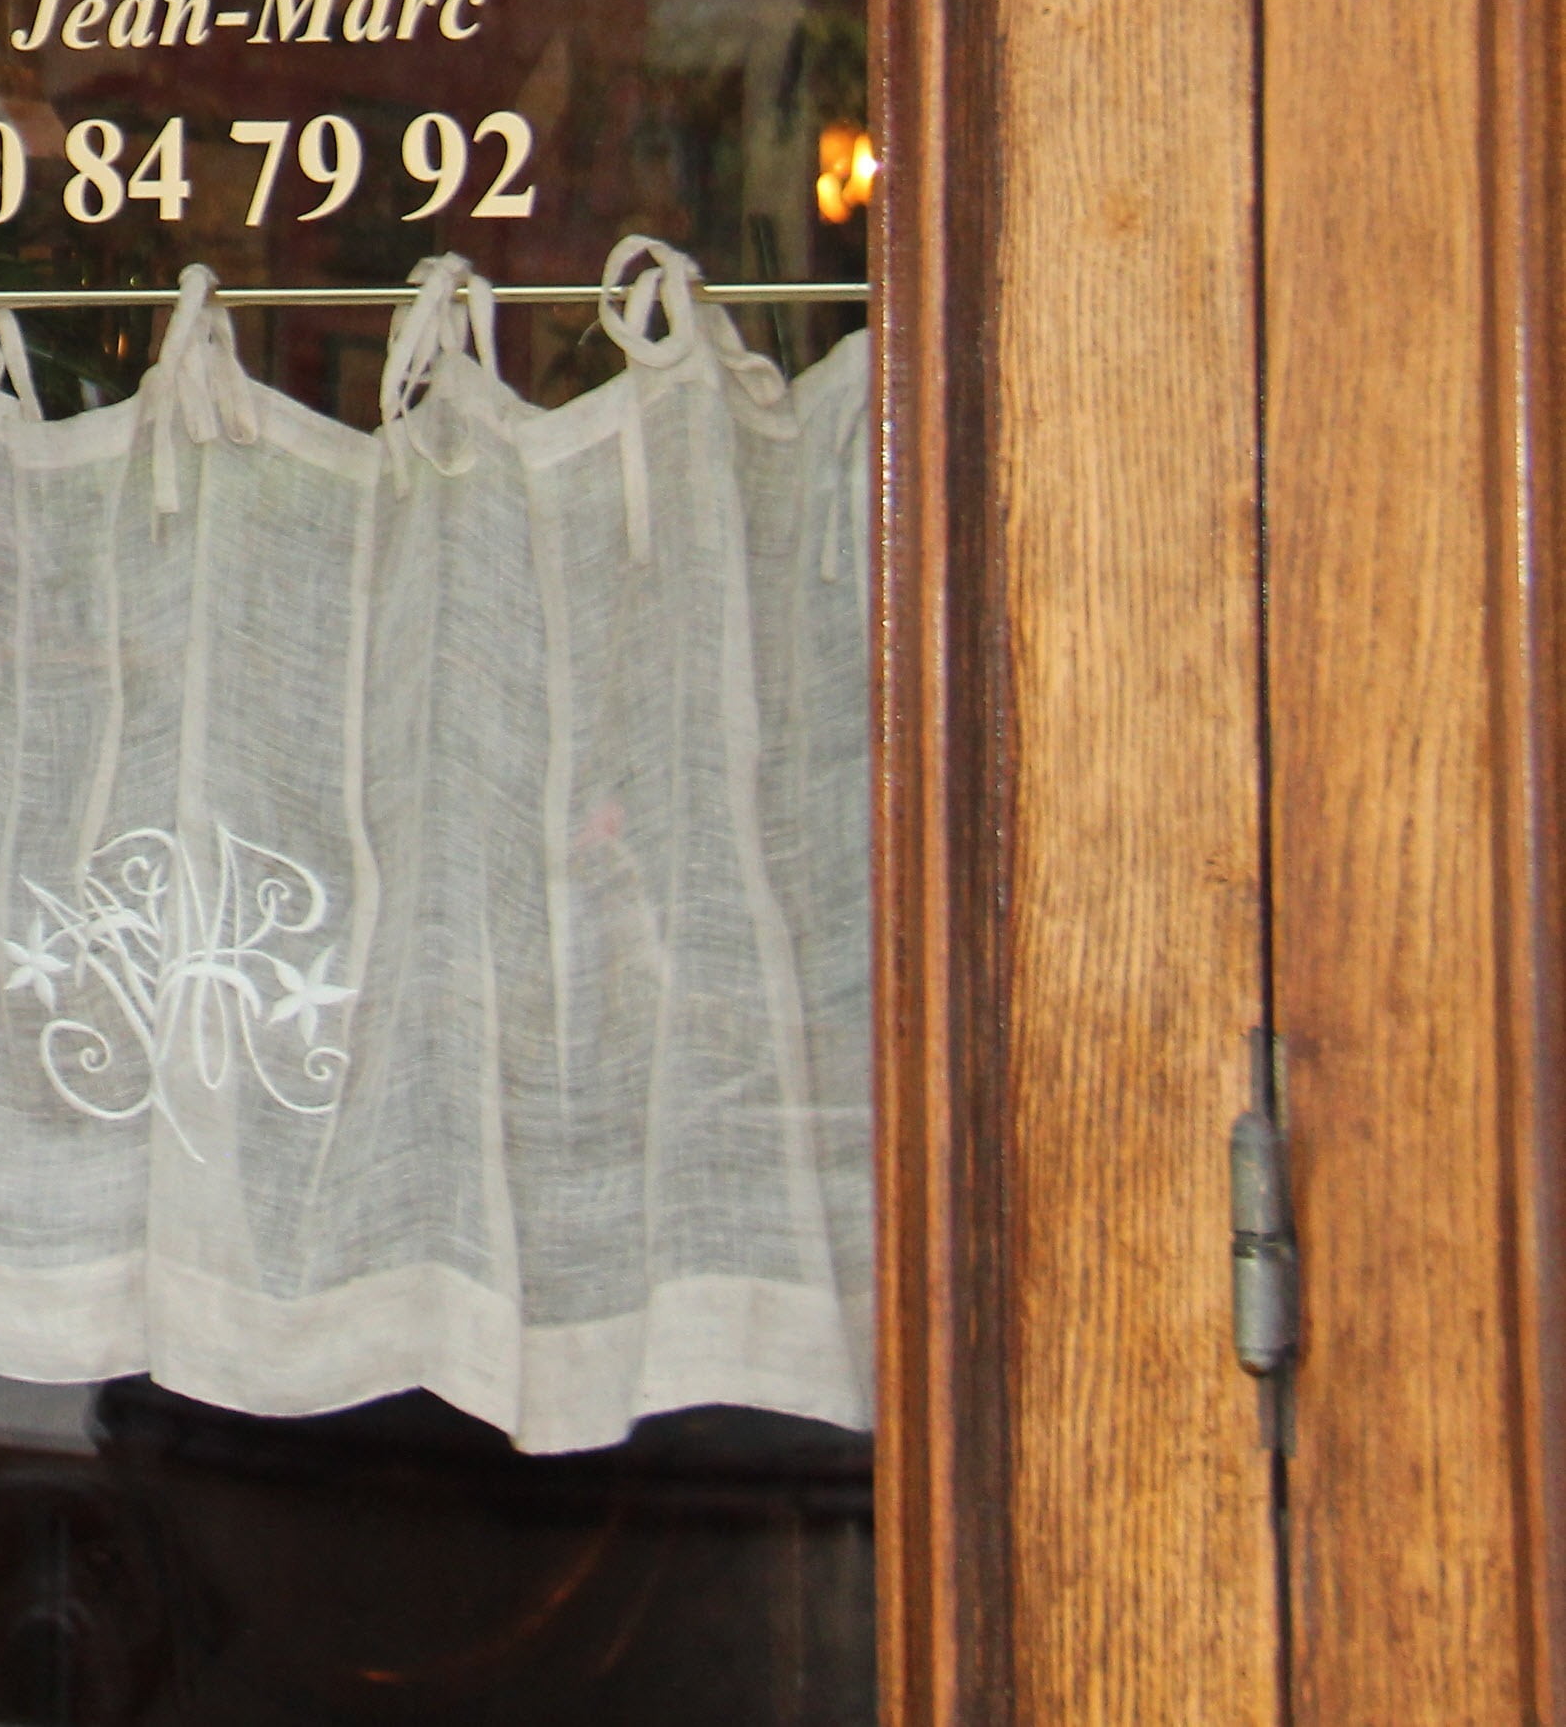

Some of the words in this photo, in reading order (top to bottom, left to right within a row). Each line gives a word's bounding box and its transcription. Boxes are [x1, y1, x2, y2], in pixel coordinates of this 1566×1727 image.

[62, 115, 192, 226] 84
[229, 114, 362, 227] 79
[400, 110, 538, 223] 92
